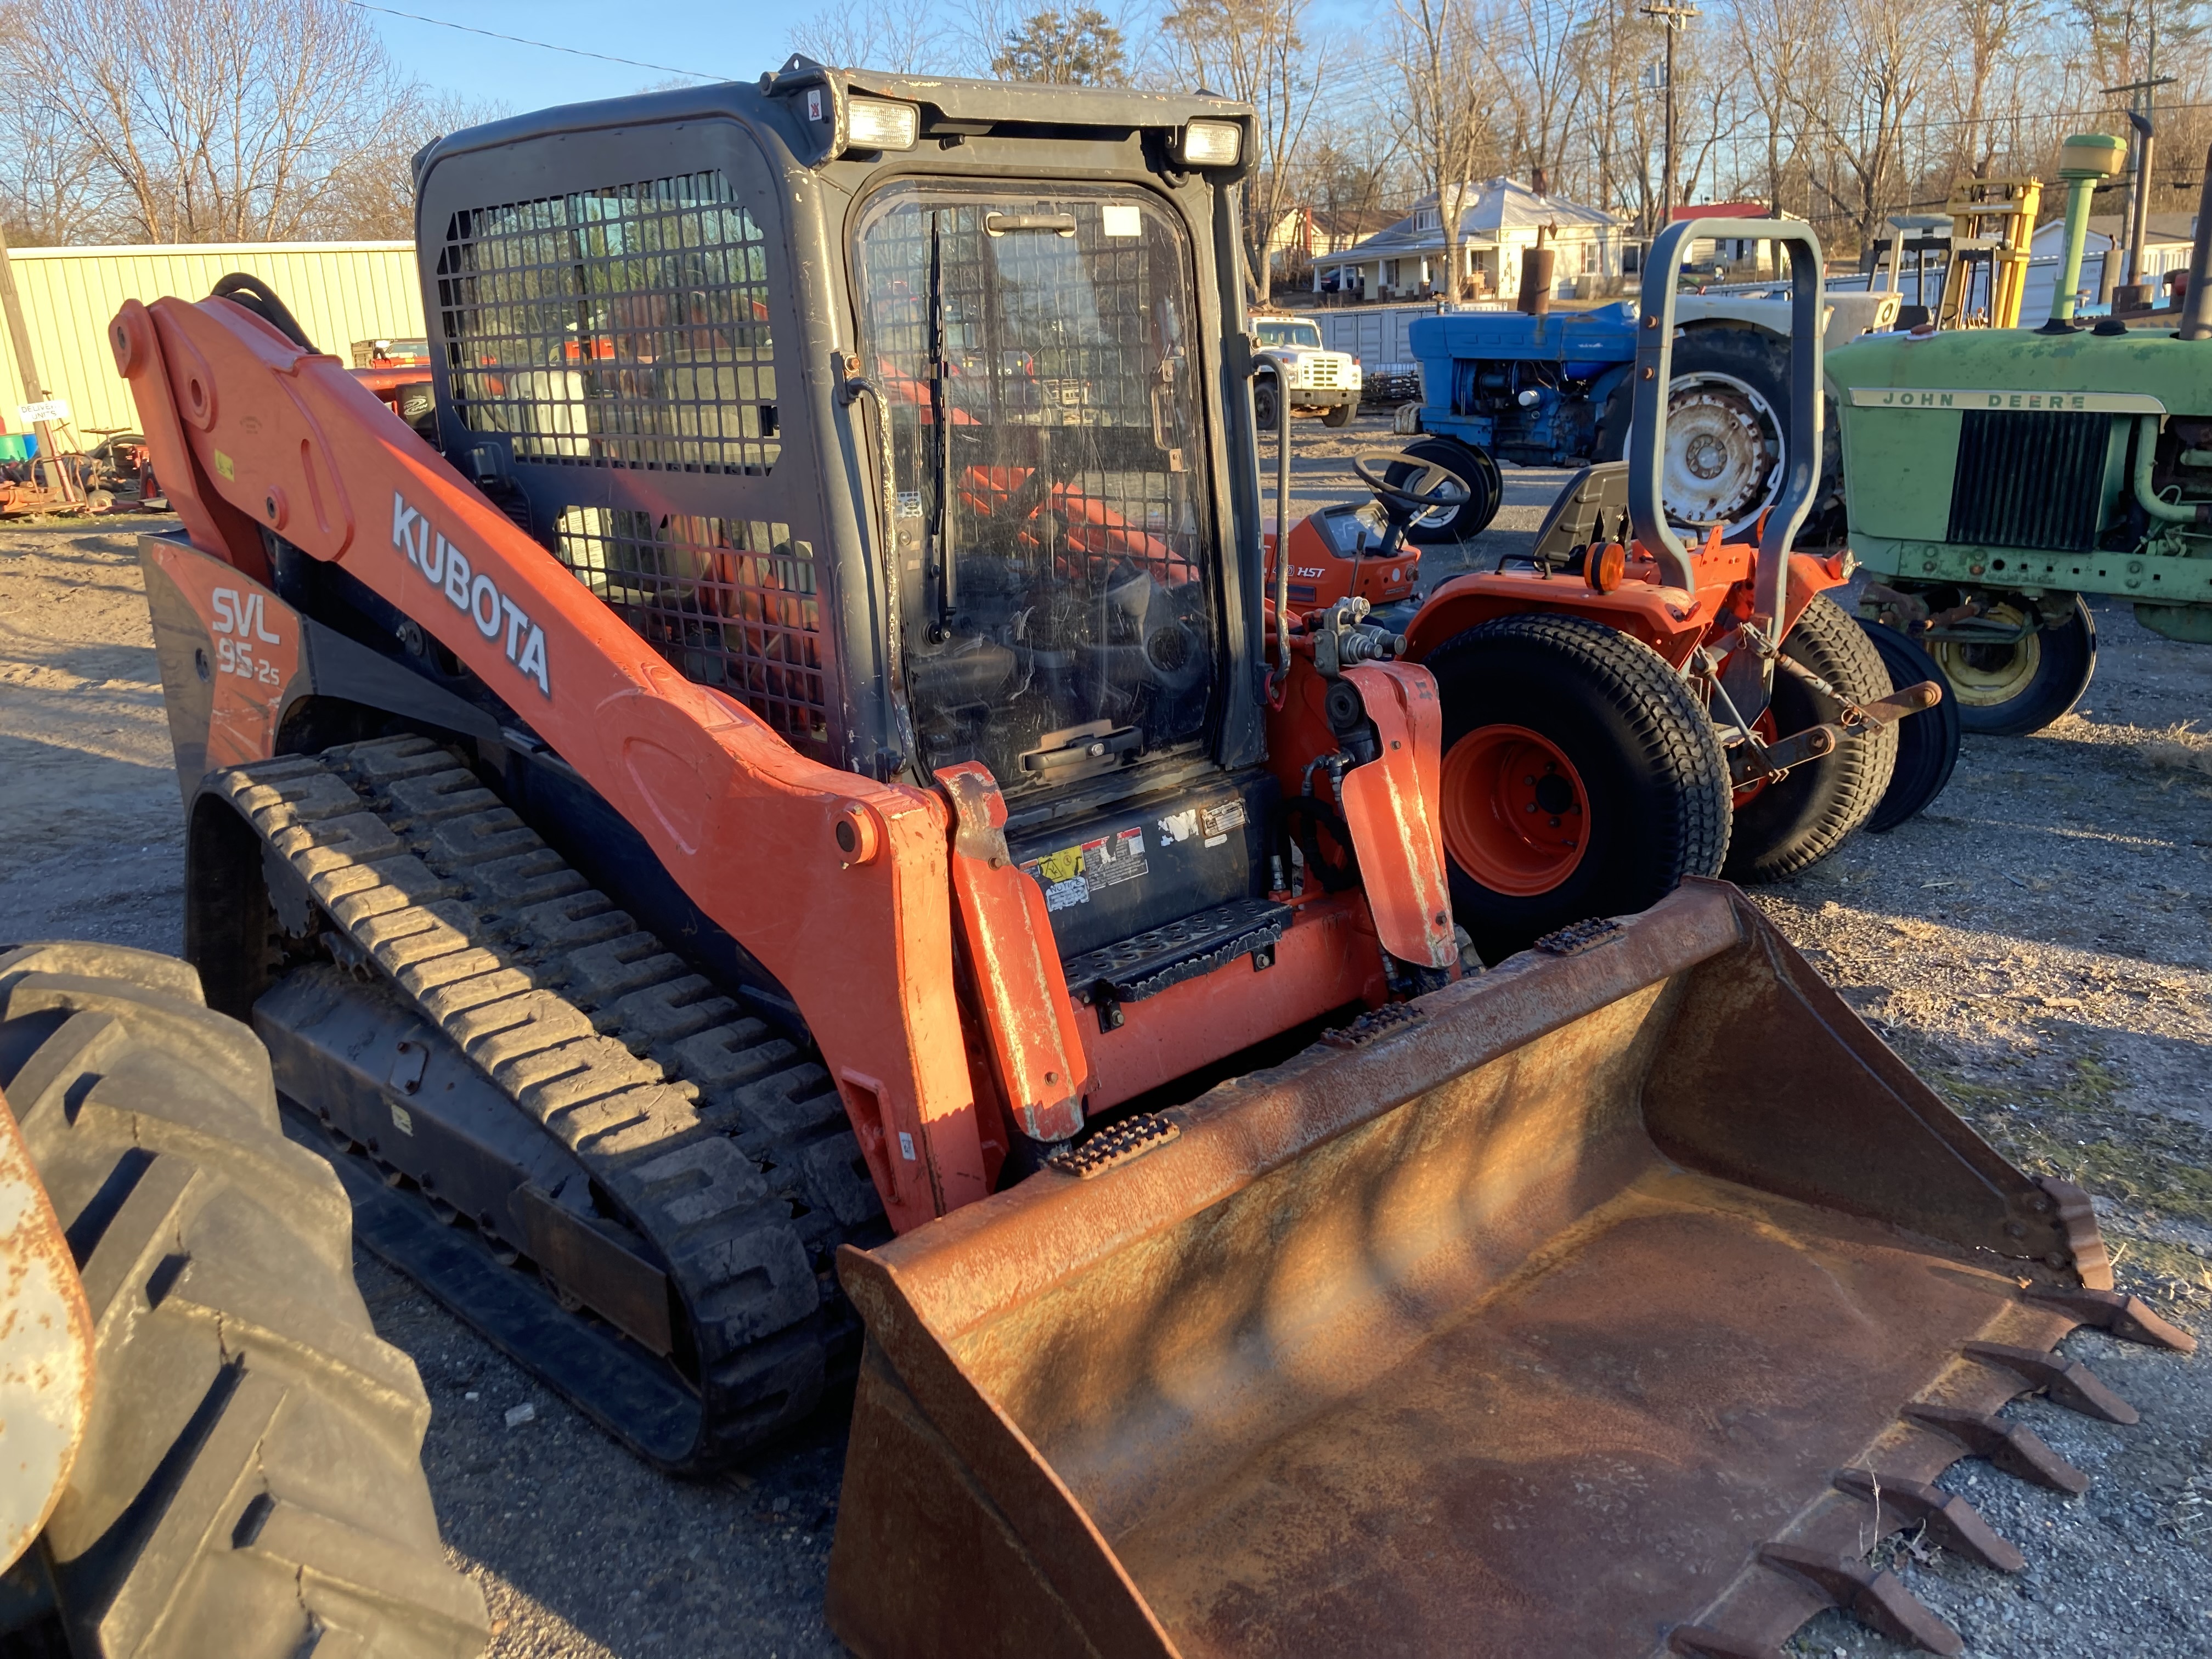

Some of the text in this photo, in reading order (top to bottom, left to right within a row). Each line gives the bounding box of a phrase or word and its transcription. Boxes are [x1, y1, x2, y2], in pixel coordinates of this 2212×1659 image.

[1883, 392, 2085, 409] JOHN DEERE
[1296, 567, 1326, 578] HST
[393, 491, 549, 693] KUBOTA
[212, 587, 280, 645] SVL
